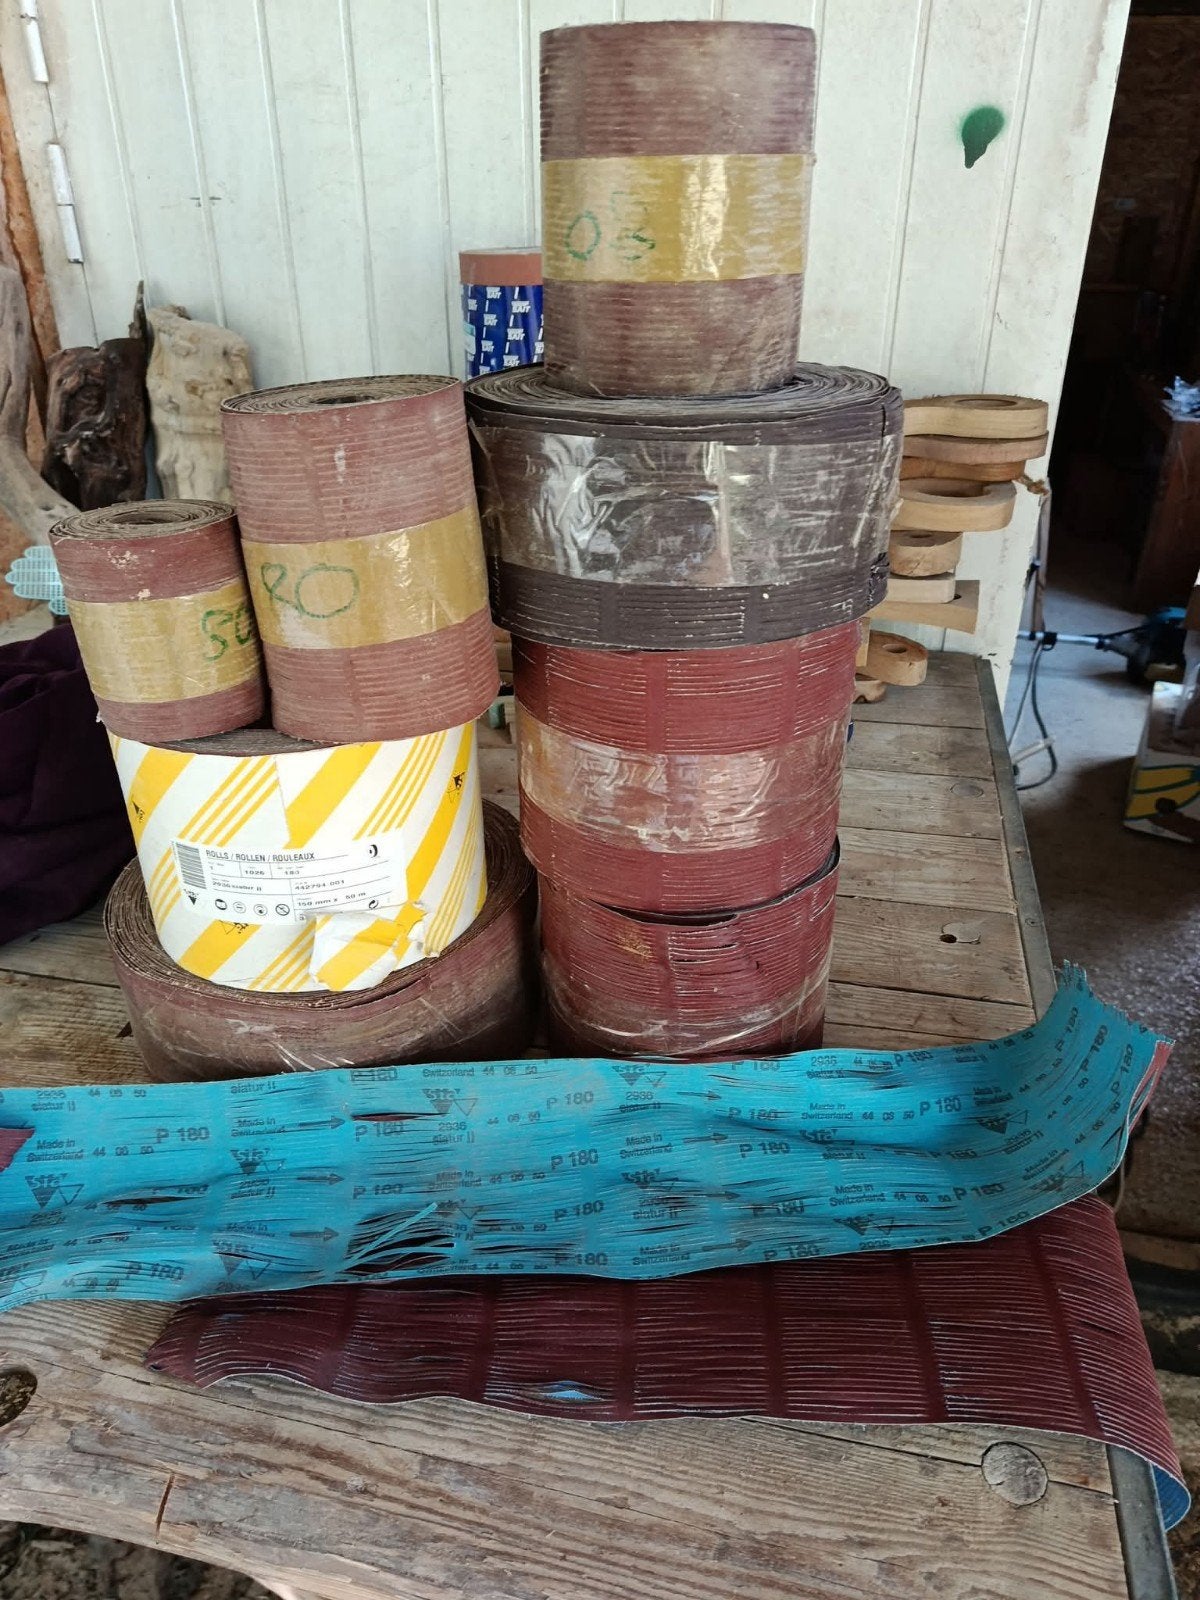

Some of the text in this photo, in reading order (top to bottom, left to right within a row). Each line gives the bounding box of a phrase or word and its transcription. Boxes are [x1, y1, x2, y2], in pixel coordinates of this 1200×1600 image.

[206, 849, 229, 860] ROLLS
[236, 853, 266, 862] ROLLEN
[272, 852, 315, 862] ROULEAUX
[546, 1091, 594, 1109] P 180
[626, 1091, 654, 1101] 2936
[920, 1097, 962, 1116] P 180
[156, 1127, 209, 1143] P 180
[438, 1122, 467, 1132] 2936
[739, 1141, 790, 1158] P 180
[551, 1149, 599, 1170] P 180
[953, 1183, 1004, 1200] P 180
[554, 1200, 604, 1221] P 180
[977, 1225, 992, 1237] P
